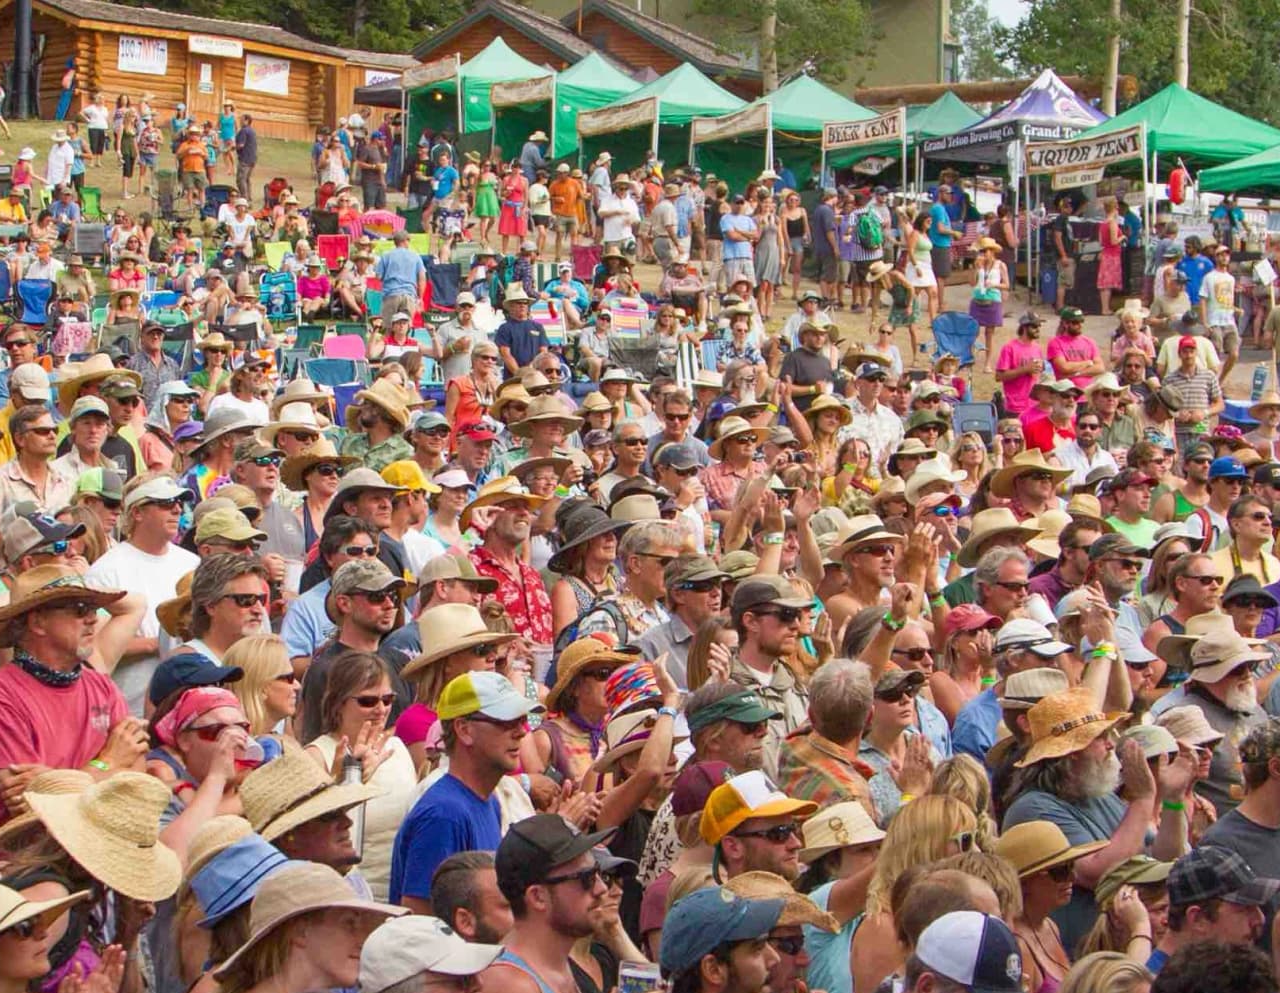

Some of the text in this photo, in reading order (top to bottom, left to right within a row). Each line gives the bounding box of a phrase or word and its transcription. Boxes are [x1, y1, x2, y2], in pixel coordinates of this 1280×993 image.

[924, 138, 946, 152] Grand
[948, 135, 969, 148] Teton
[970, 128, 1002, 146] Brewing
[1022, 124, 1061, 138] Grand
[1030, 134, 1139, 167] LIQUOR TENT
